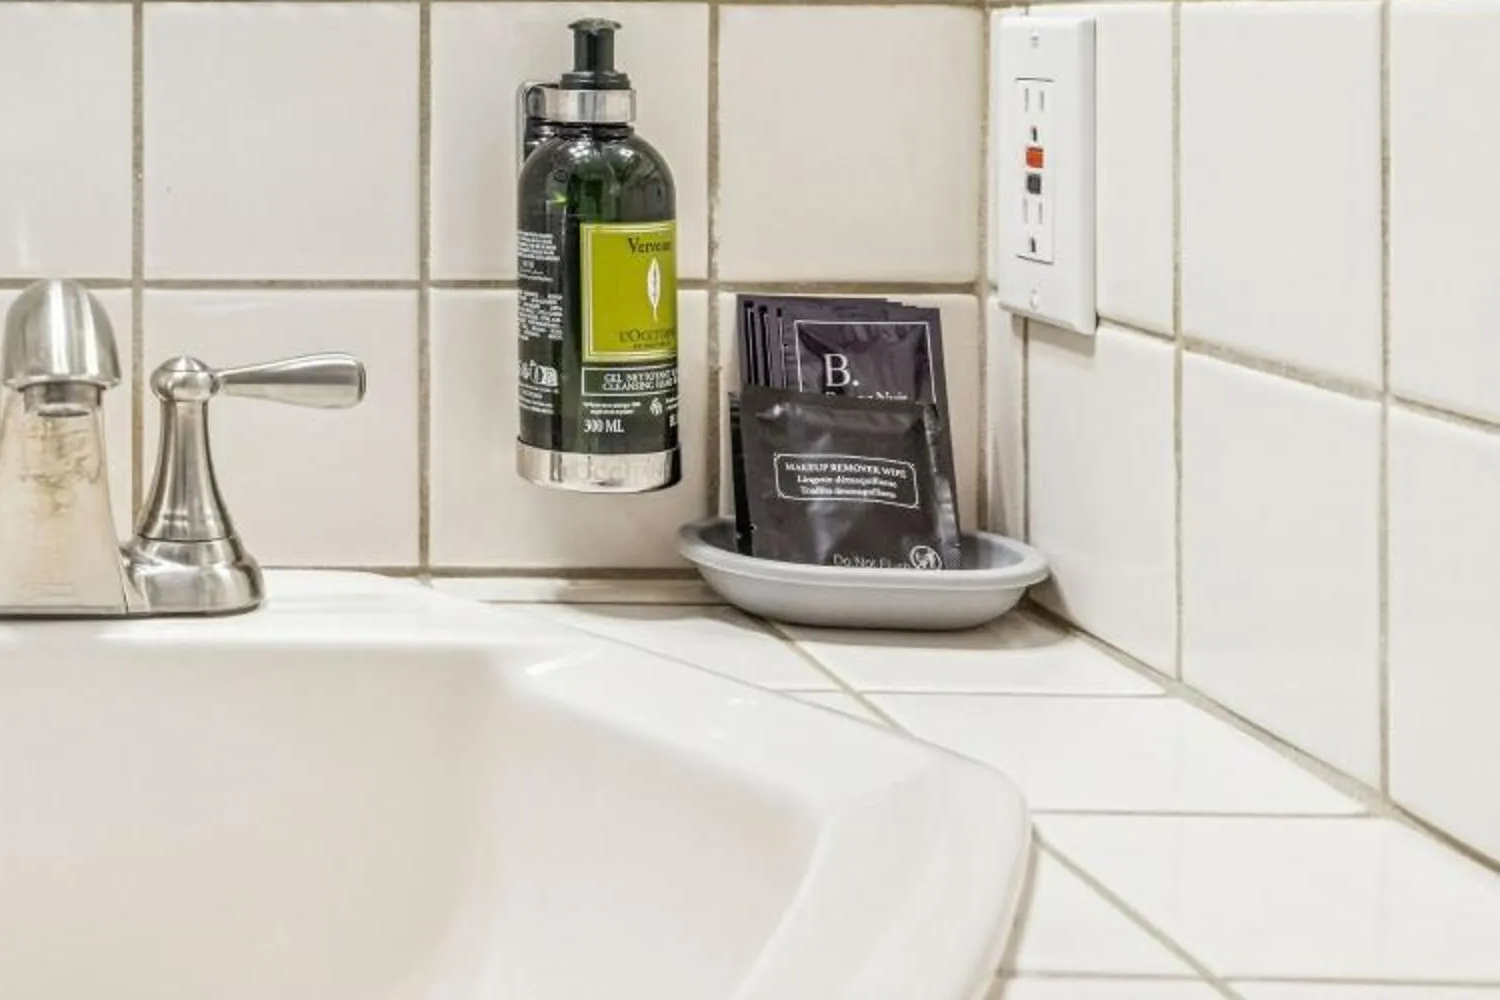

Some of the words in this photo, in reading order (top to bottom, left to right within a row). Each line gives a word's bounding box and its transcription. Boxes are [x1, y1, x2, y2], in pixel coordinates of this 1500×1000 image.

[627, 236, 672, 255] Verve
[583, 419, 603, 433] 300
[605, 418, 625, 433] ML
[830, 463, 881, 475] REMOVER
